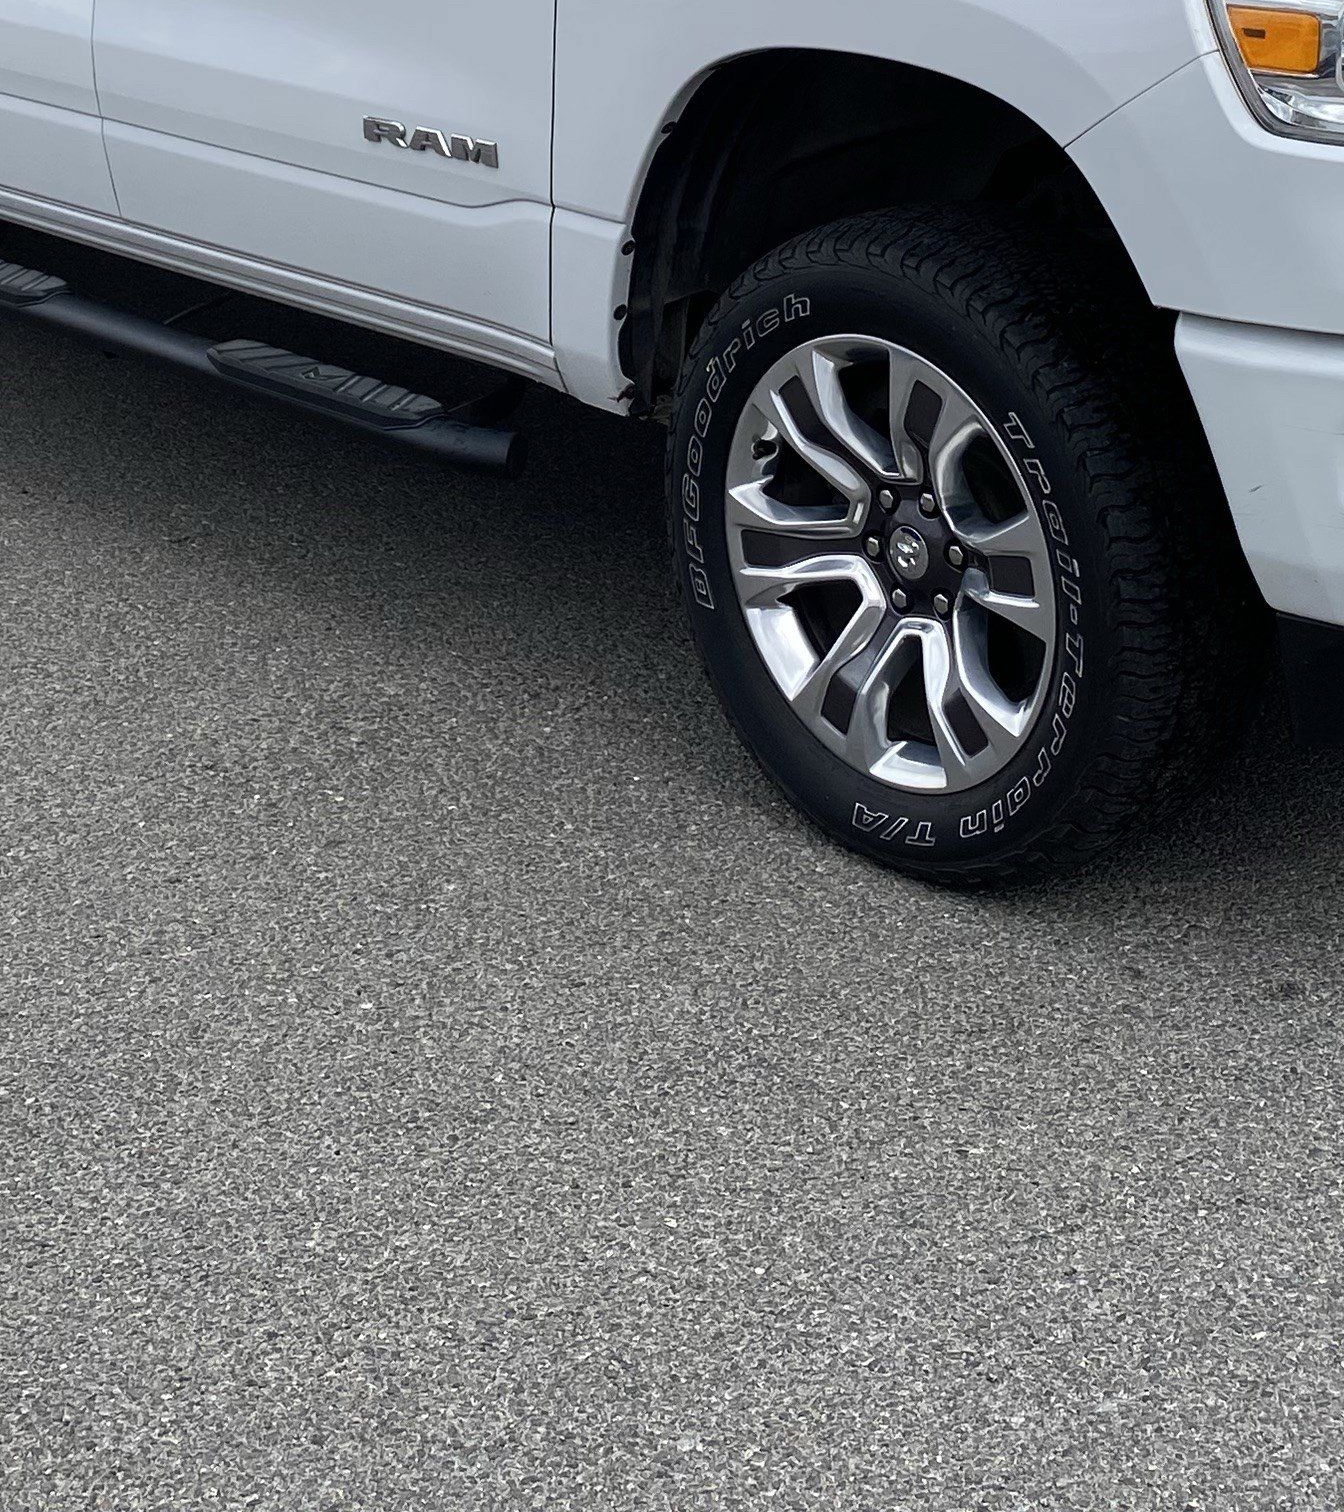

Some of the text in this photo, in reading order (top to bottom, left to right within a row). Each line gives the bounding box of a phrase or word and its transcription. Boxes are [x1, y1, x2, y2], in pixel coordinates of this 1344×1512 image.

[363, 114, 500, 170] RAM
[682, 293, 811, 610] BFGoodrich
[851, 802, 937, 847] T/A
